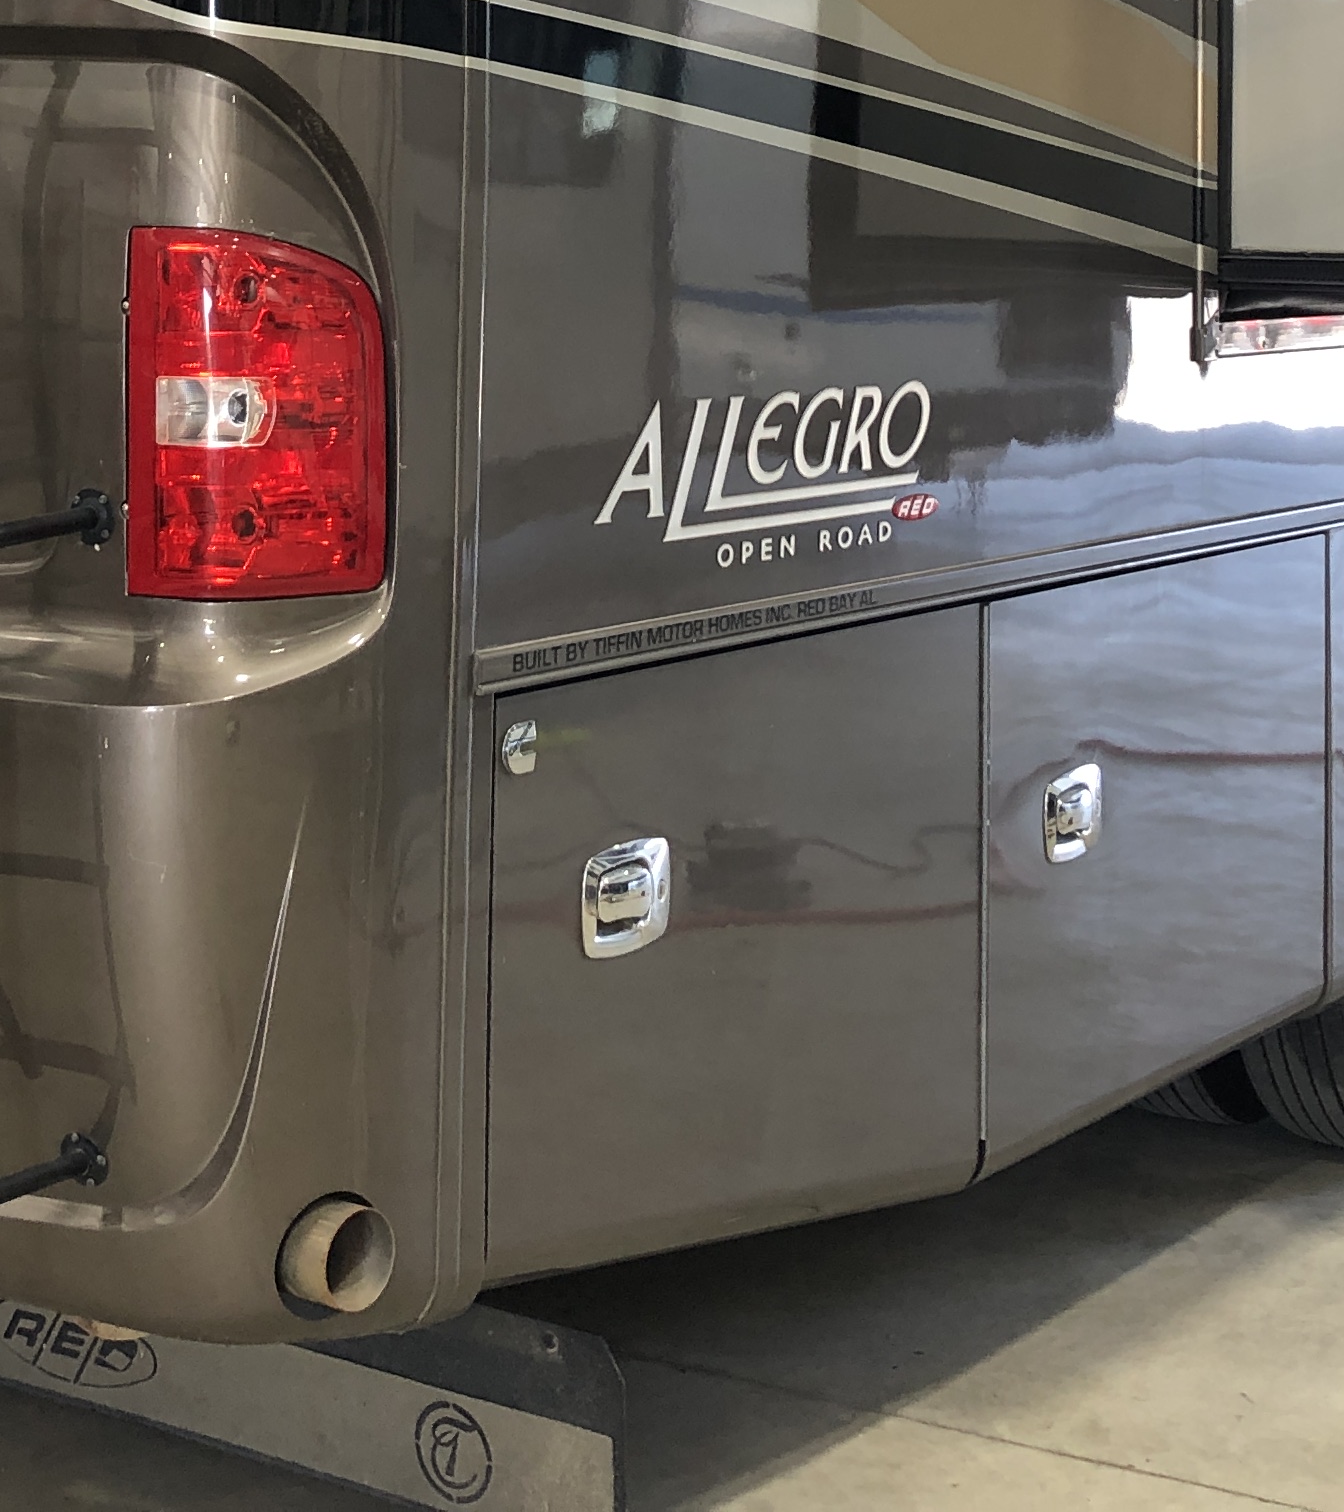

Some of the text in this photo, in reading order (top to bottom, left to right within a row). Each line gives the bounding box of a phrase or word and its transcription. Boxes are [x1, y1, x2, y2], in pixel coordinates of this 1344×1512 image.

[593, 379, 932, 543] ALLEGRO
[896, 496, 936, 518] RED
[716, 520, 893, 569] OPEN ROAD
[512, 644, 562, 673] BUILT
[565, 640, 588, 664] BY
[593, 629, 643, 658] TIFFIN
[646, 620, 705, 647] MOTOR
[708, 610, 763, 635] HOMES
[797, 598, 827, 620] RED
[828, 592, 857, 613] BAY
[859, 589, 878, 607] AL
